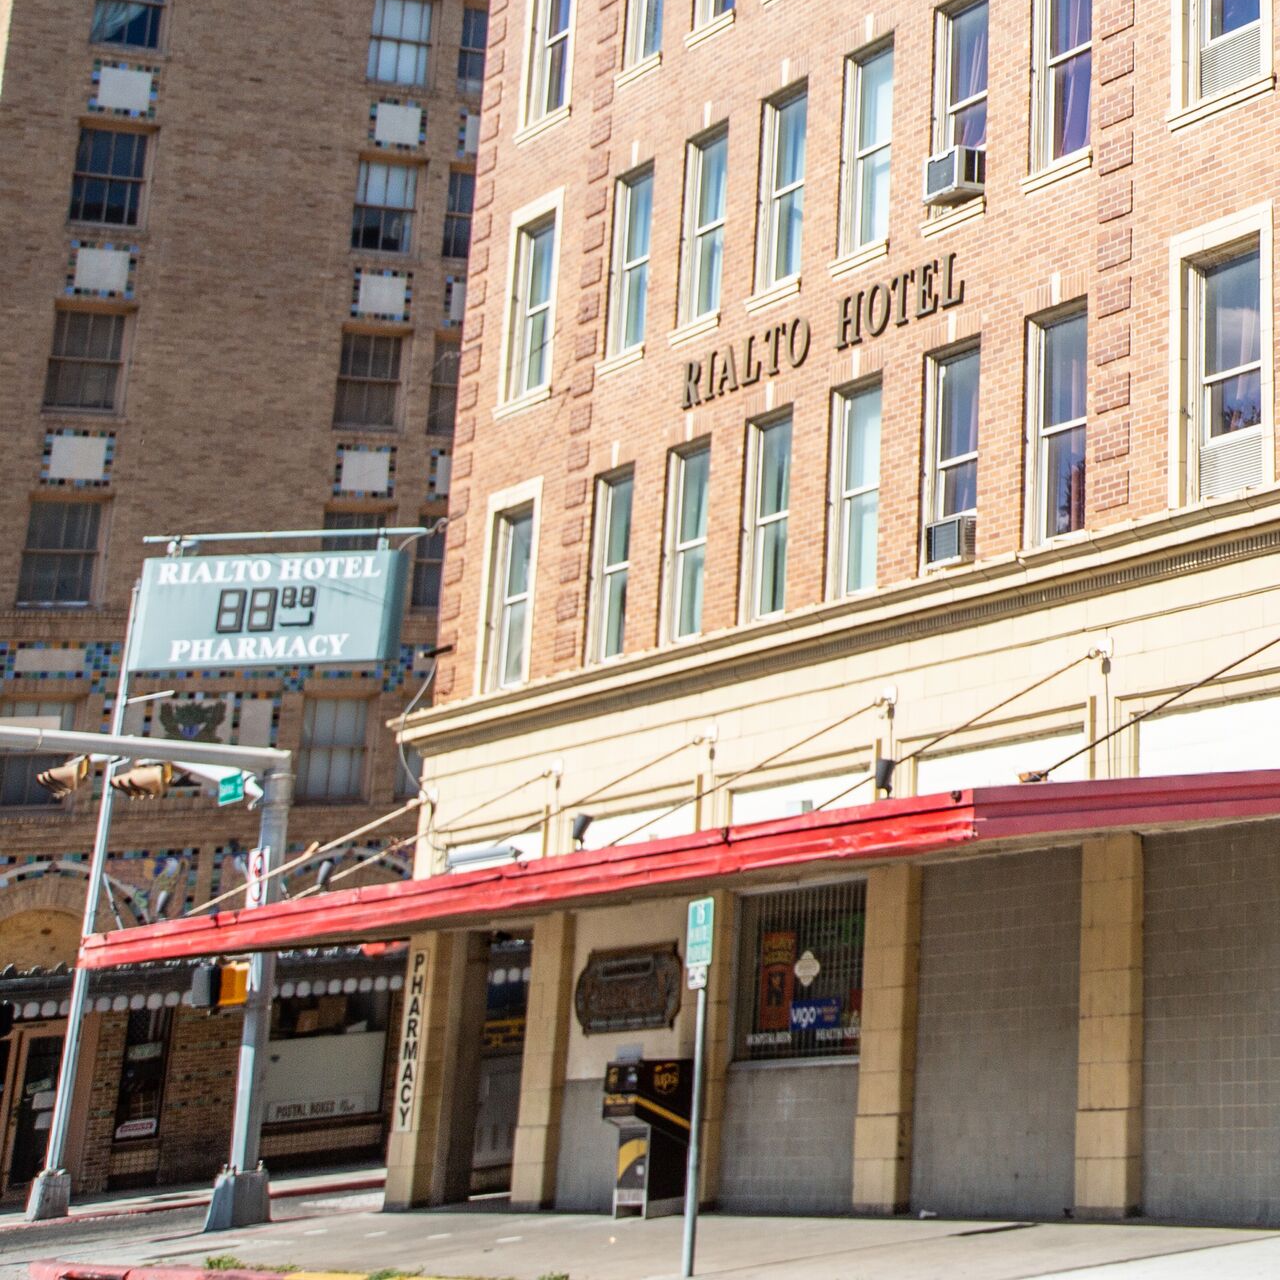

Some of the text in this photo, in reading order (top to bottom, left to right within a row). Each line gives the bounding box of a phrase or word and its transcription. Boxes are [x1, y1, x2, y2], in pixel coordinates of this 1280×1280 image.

[681, 252, 965, 409] RIALTO HOTEL
[158, 556, 381, 585] RIALTO HOTEL
[168, 633, 350, 662] PHARMACY
[400, 953, 425, 1126] PHARMACY
